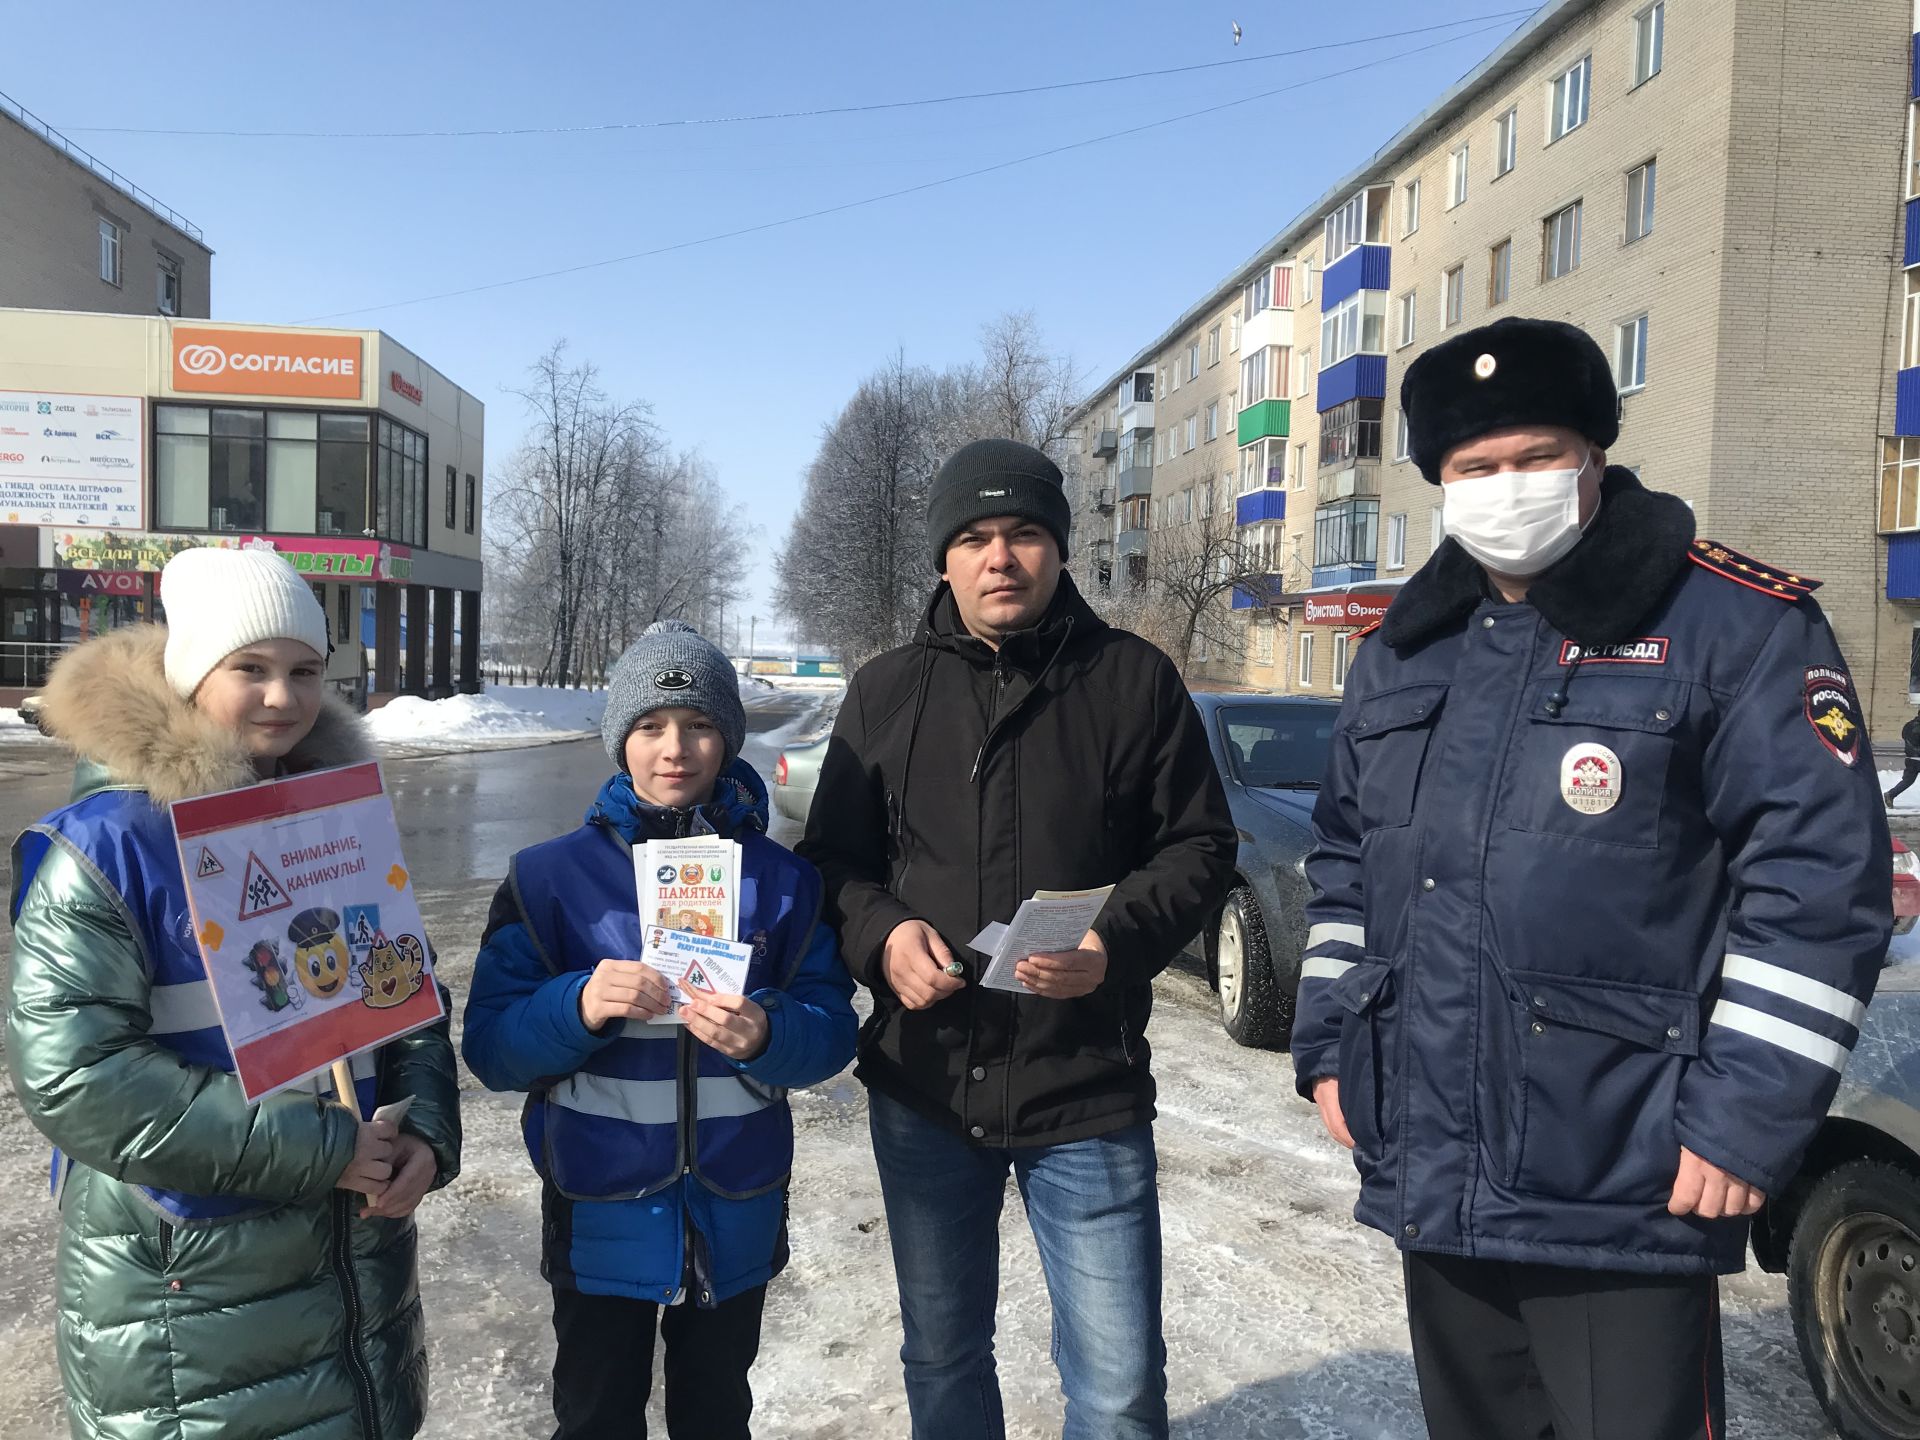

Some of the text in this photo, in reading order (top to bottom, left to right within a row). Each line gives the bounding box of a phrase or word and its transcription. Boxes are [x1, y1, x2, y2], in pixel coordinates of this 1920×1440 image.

[229, 353, 354, 375] СОГЛАСИЕ
[55, 403, 75, 413] zetta
[5, 482, 34, 490] ГИБДД
[40, 484, 76, 492] ОПЛАТА
[63, 493, 100, 501] НАЛОГИ
[59, 502, 108, 511] ПЛАТЕЖЕЙ
[116, 504, 136, 512] ЖКХ
[68, 548, 97, 559] ВСЕ
[101, 549, 132, 560] ДЛЯ
[1306, 600, 1344, 621] Бристоль
[1808, 668, 1847, 686] ПОЛИЦИЯ
[1812, 690, 1850, 710] РОССИЯ
[1569, 787, 1611, 797] ПОЛИЦИЯ
[280, 835, 362, 868] ВНИМАНИЕ,
[286, 856, 366, 892] КАНИКУЛЫ!
[658, 886, 726, 899] ПАМЯТКА
[679, 899, 722, 908] родителей
